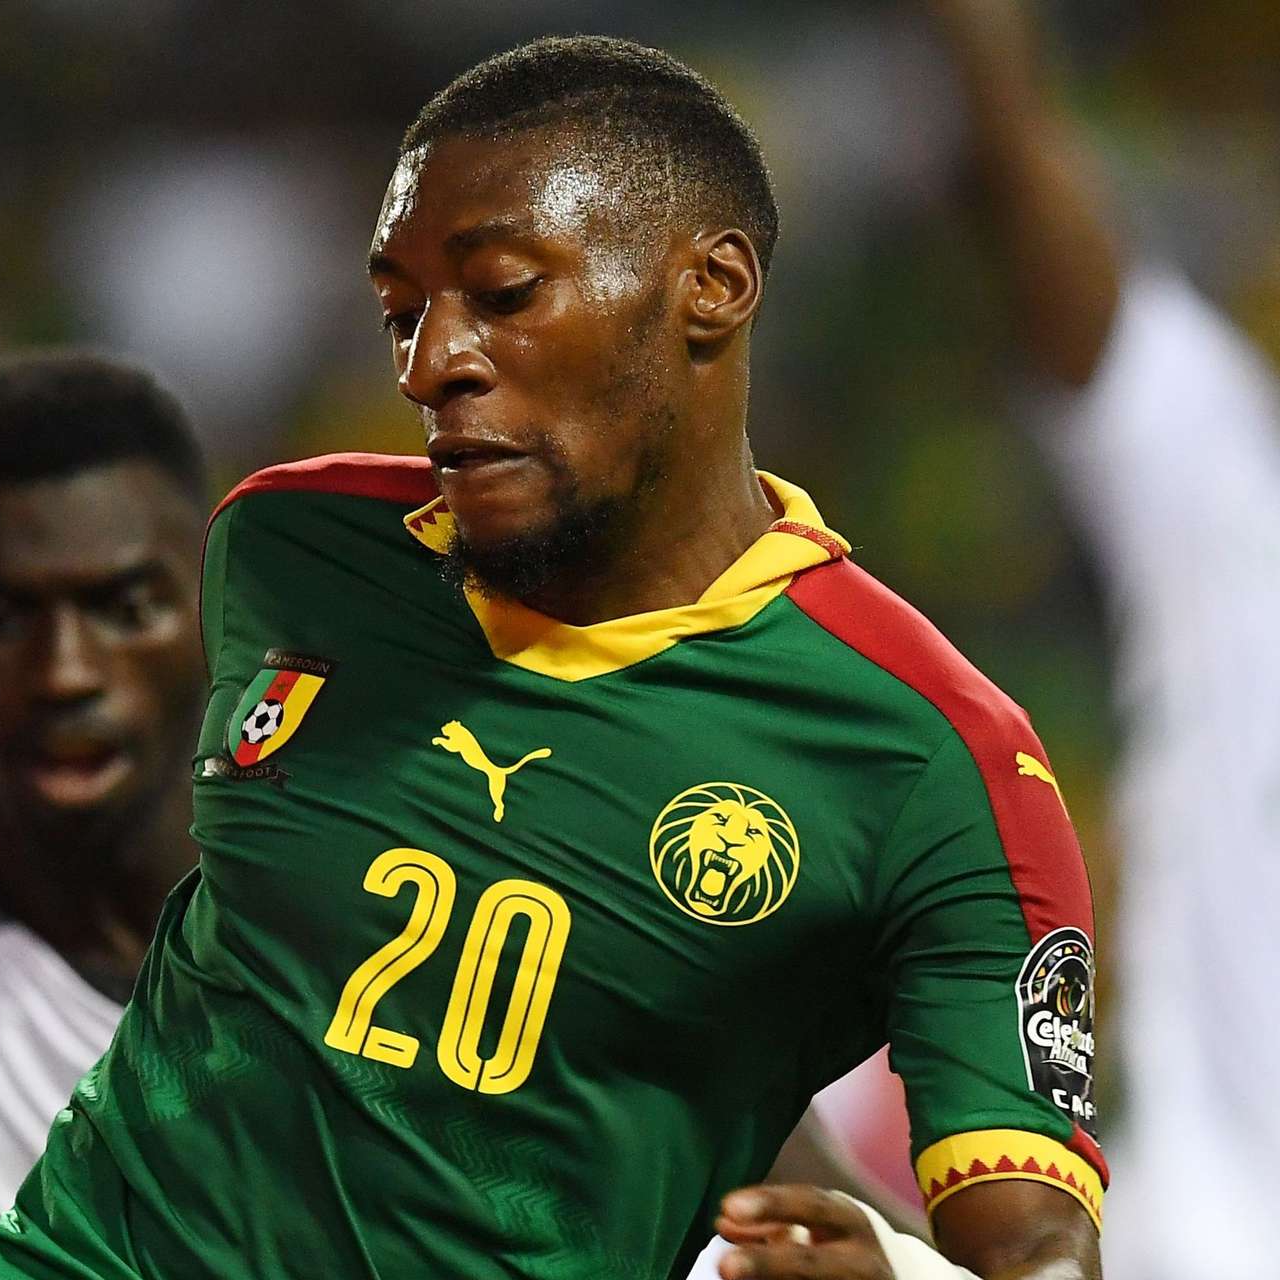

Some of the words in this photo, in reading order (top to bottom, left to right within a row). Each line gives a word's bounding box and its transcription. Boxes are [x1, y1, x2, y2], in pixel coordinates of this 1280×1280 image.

[267, 655, 330, 673] CAMEROUN
[324, 847, 571, 1095] 20
[1027, 1010, 1095, 1057] Celeate
[1052, 1088, 1096, 1120] CAF
